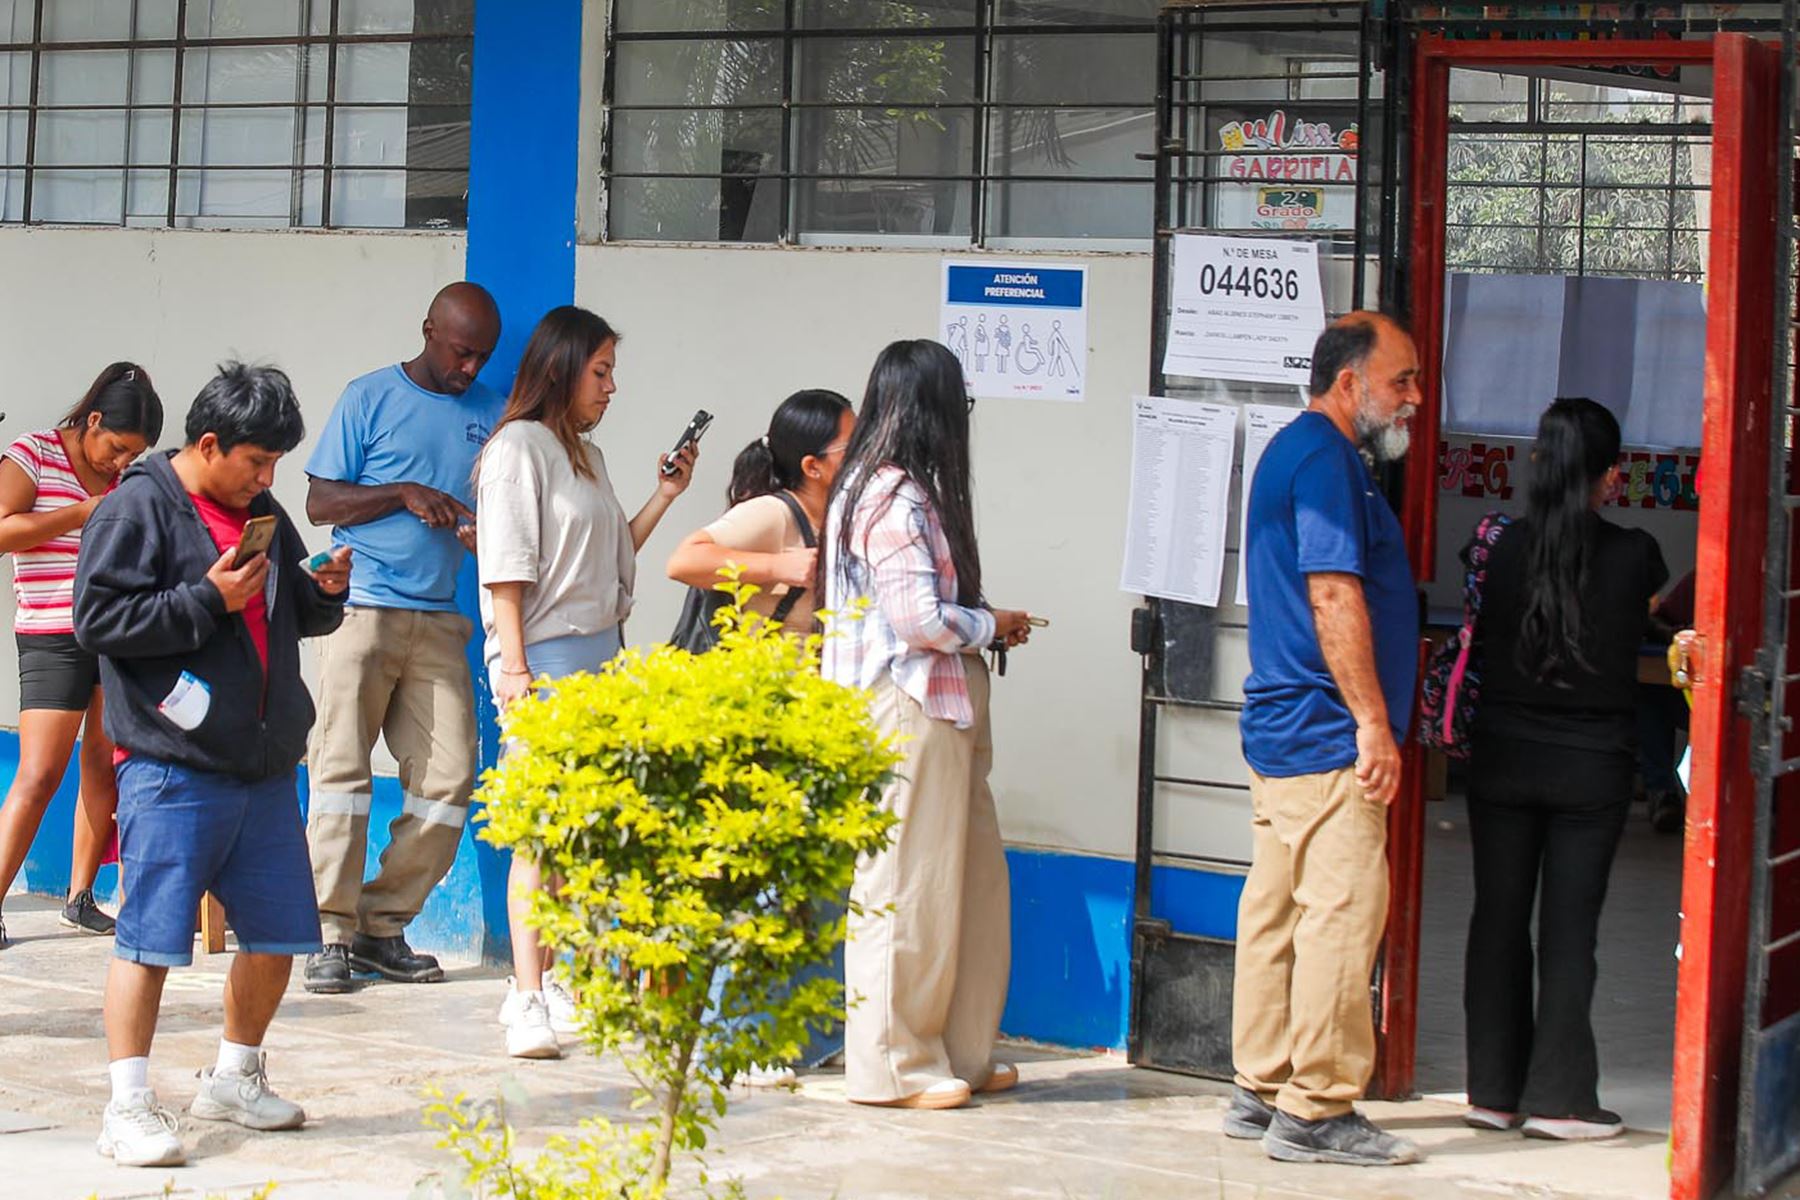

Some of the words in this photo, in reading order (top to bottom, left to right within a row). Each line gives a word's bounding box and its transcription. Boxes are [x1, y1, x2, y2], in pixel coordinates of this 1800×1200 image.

[1256, 204, 1314, 218] Grado
[1237, 248, 1249, 259] DE
[1252, 248, 1279, 260] MESA
[993, 273, 1038, 285] ATENCIÓN
[1200, 263, 1299, 301] 044636
[984, 287, 1046, 299] PREFERENCIAL
